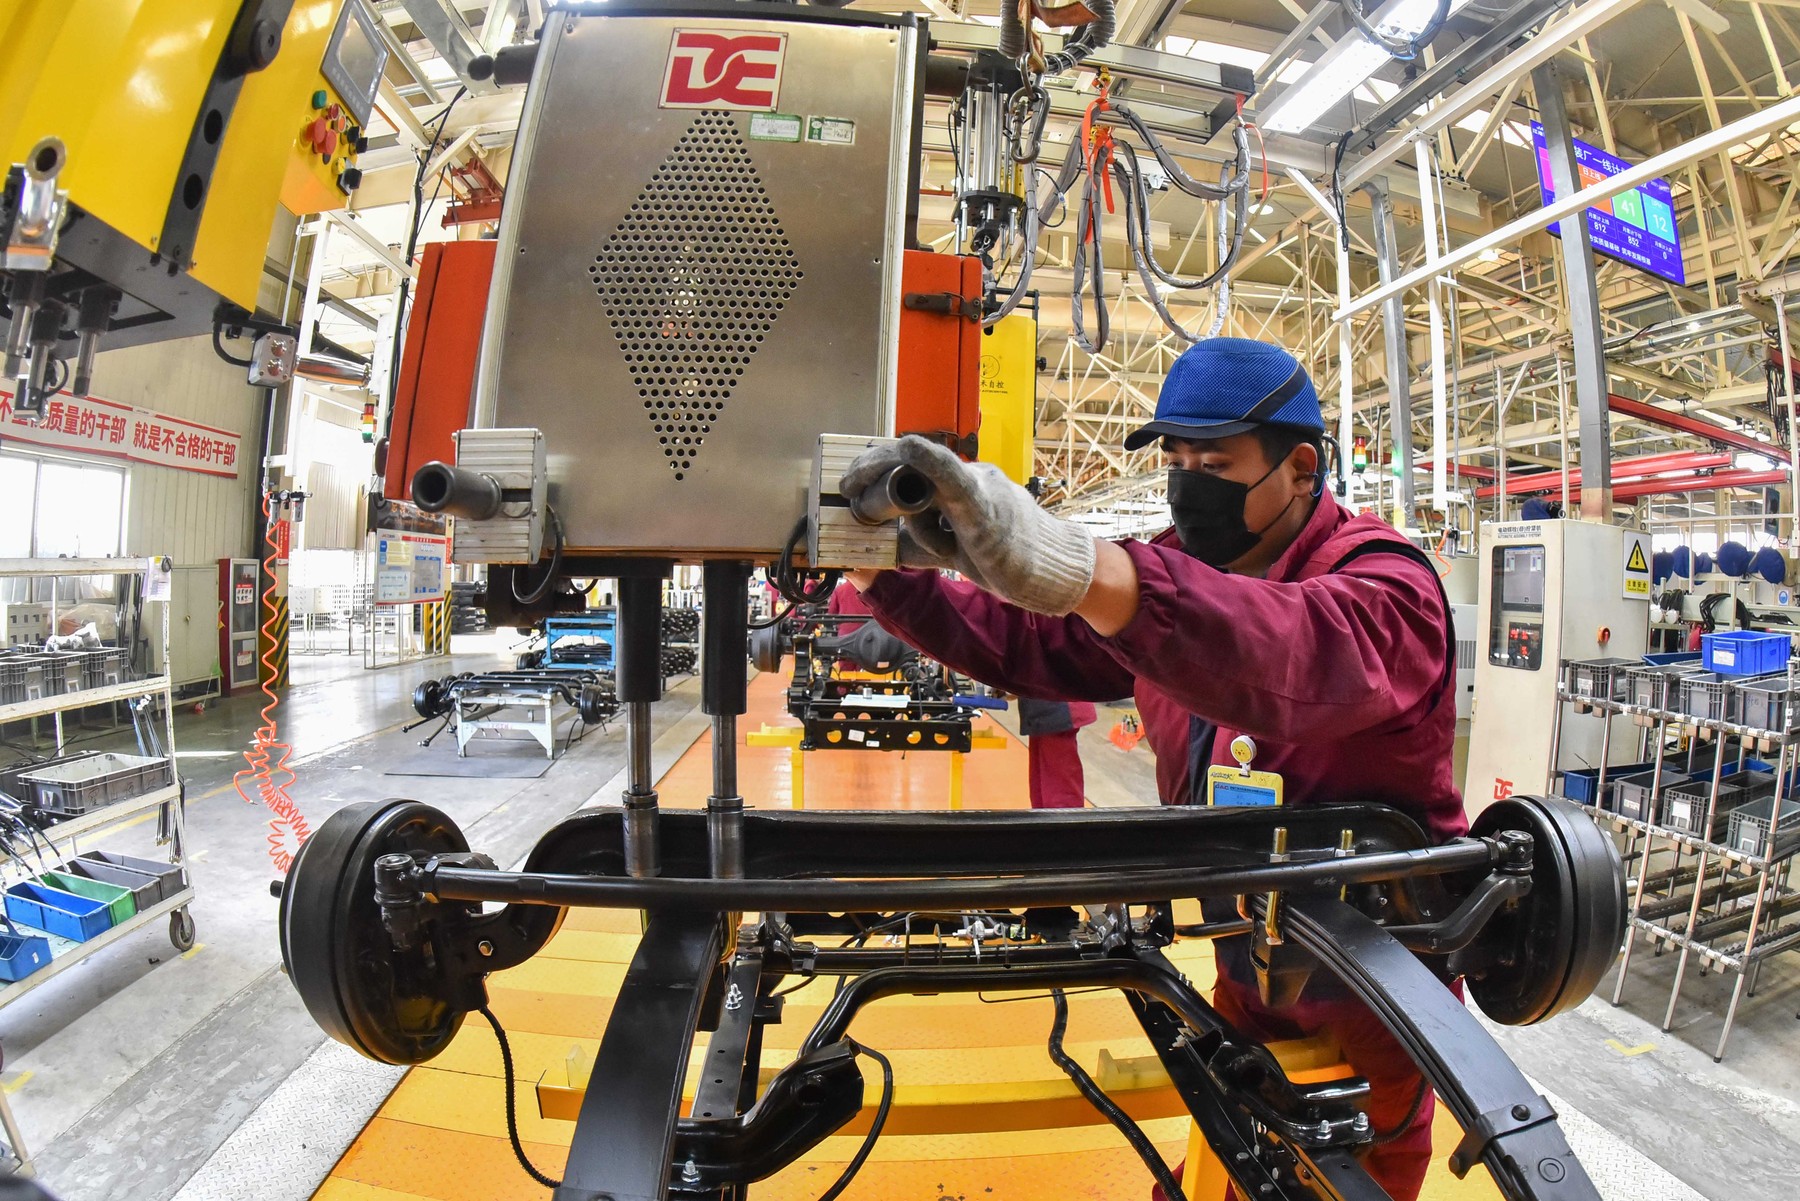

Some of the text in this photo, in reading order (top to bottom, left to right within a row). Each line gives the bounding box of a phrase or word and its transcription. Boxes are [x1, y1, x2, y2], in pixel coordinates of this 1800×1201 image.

[1621, 199, 1636, 218] 41
[1593, 221, 1608, 234] 812
[1652, 213, 1669, 233] 12
[1627, 235, 1640, 248] 852
[0, 390, 237, 467] 不质量的干部 就是不合格的干部
